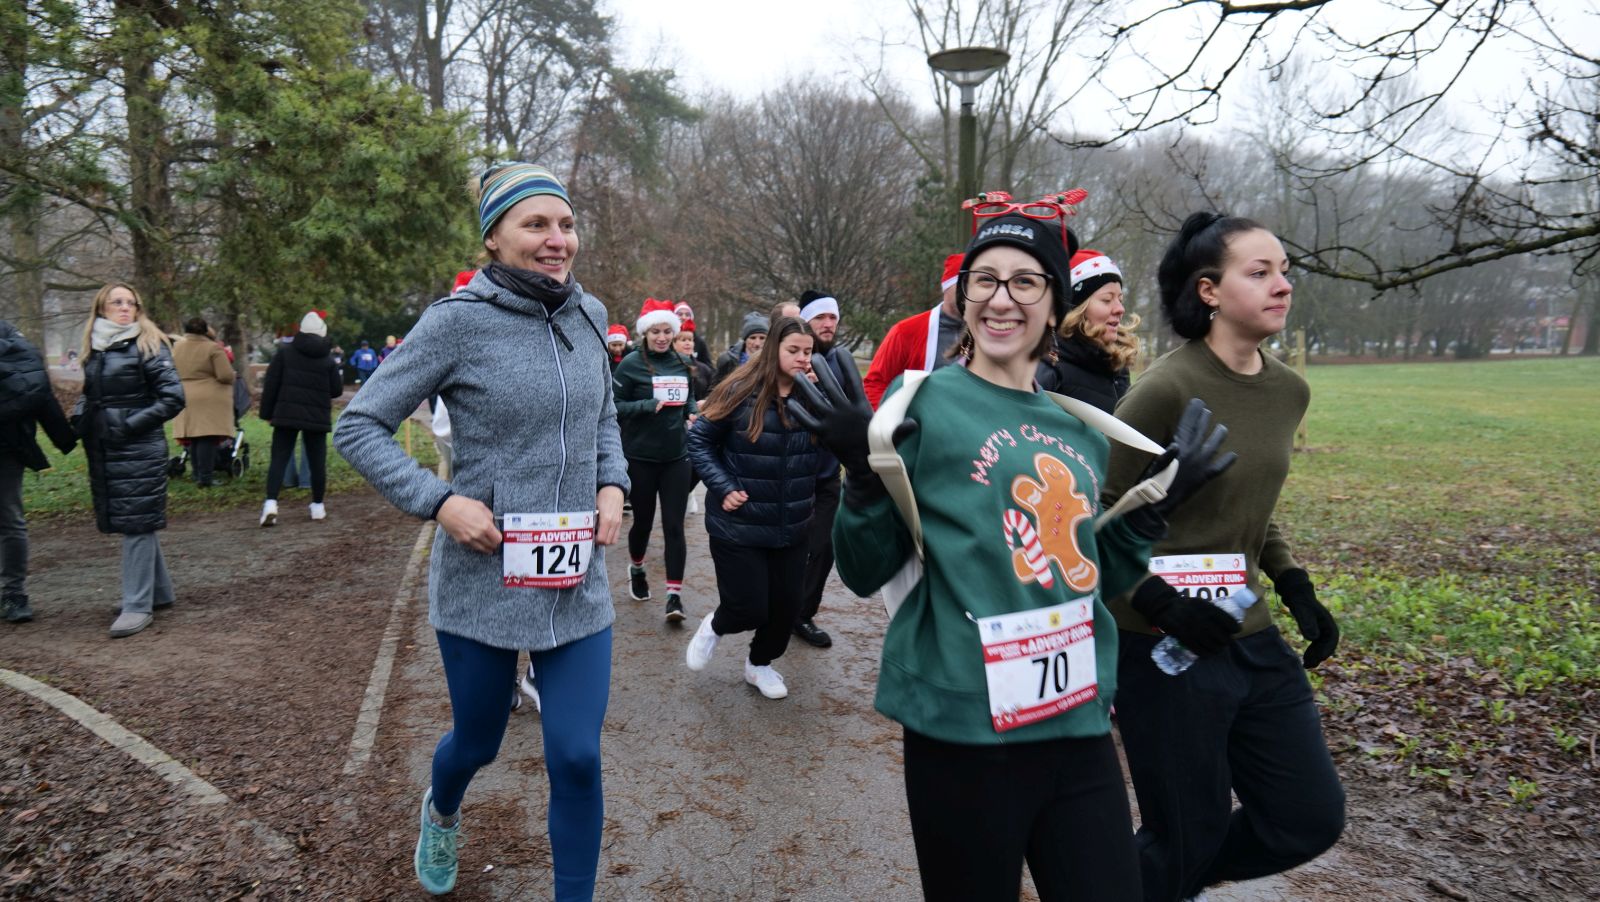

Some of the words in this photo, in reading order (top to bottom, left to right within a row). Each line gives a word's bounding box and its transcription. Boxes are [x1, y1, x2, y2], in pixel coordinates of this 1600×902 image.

[668, 388, 680, 401] 59
[970, 428, 1018, 486] Merry
[531, 543, 580, 575] 124
[1031, 651, 1068, 699] 70
